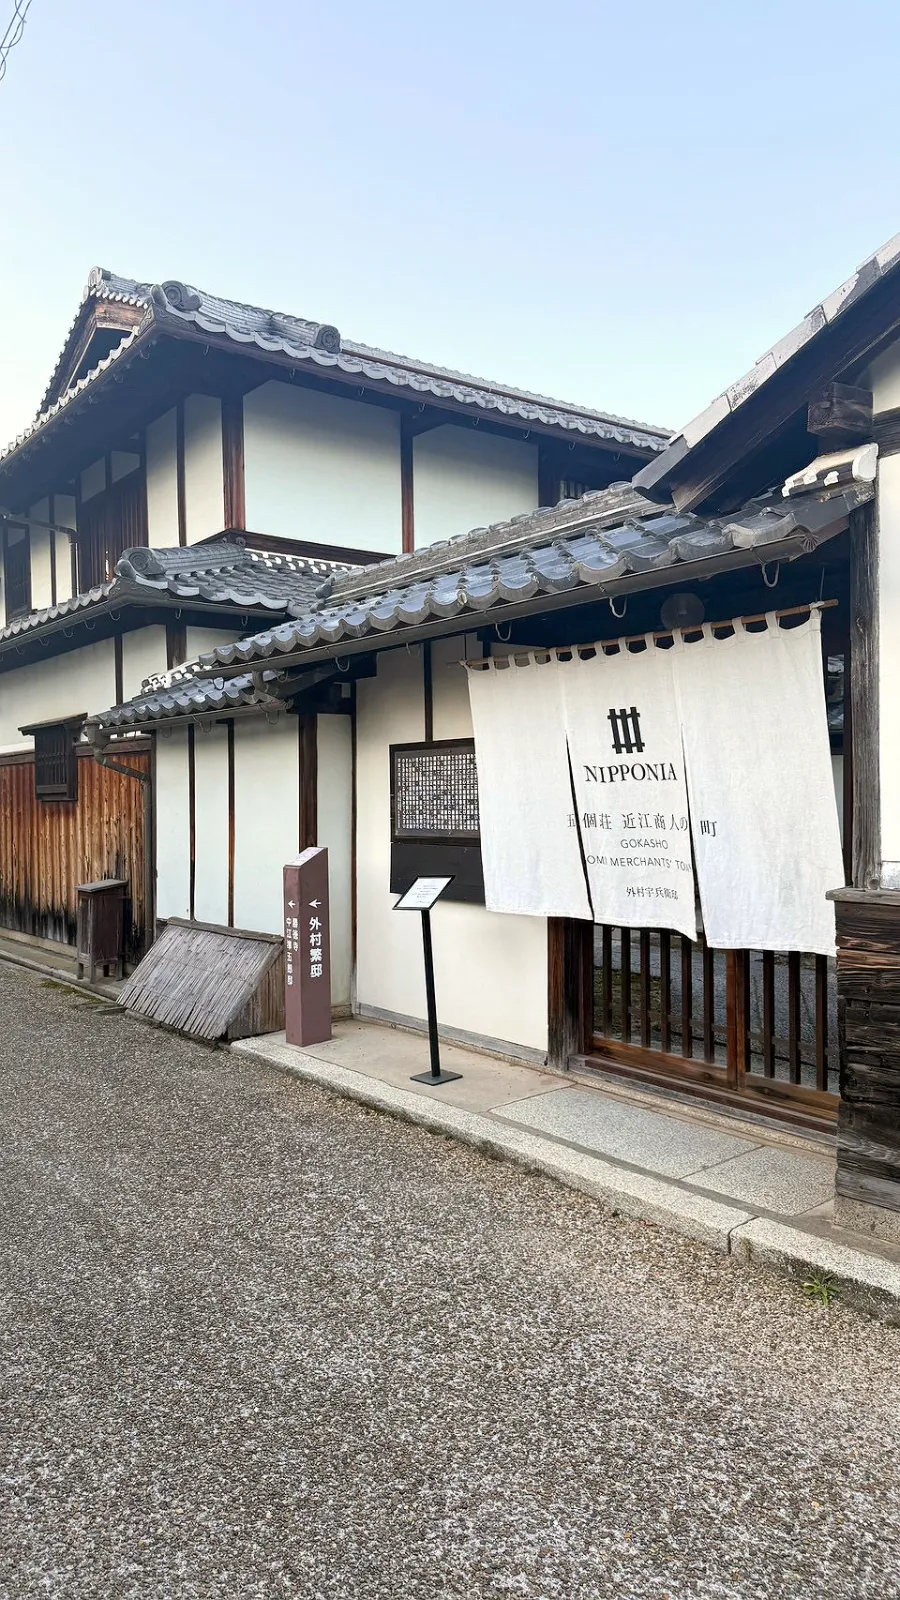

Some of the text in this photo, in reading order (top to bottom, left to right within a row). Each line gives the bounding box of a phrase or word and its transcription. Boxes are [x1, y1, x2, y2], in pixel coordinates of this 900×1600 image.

[583, 762, 678, 783] NIPPONIA
[620, 838, 669, 850] GOKASHO
[309, 916, 323, 978] 外村繁邸
